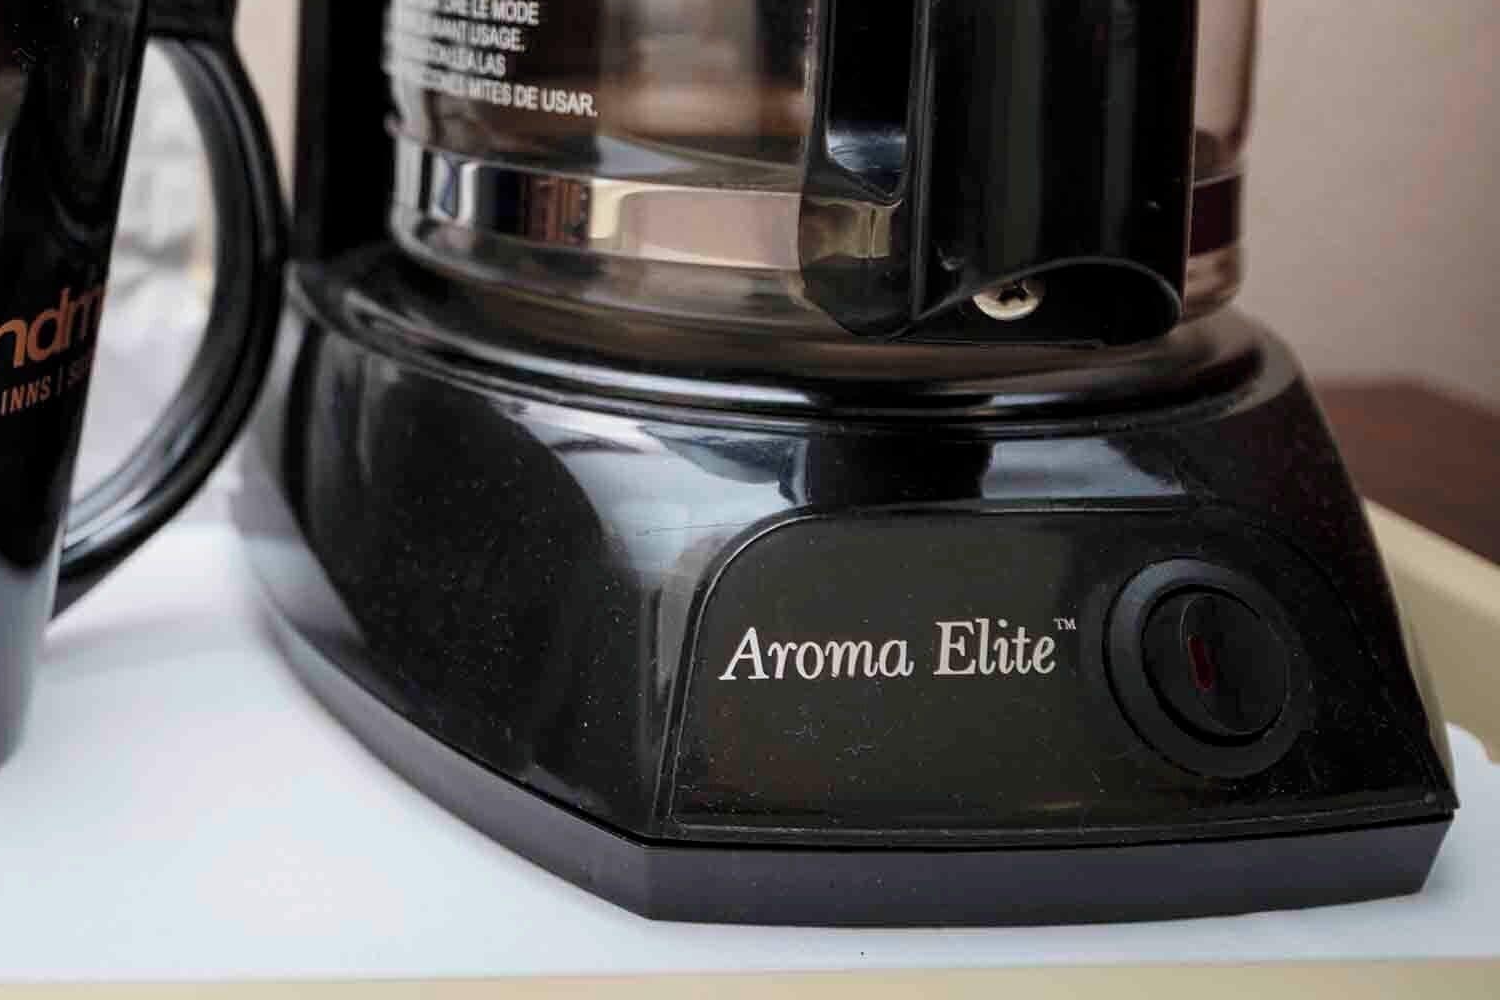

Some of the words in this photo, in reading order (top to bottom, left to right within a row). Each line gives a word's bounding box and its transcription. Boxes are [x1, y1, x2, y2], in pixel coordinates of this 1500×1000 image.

[491, 0, 540, 26] MODE
[470, 24, 526, 52] USAGE.
[513, 83, 539, 109] DE
[541, 88, 598, 118] USAR.
[0, 374, 52, 417] INNS
[718, 625, 914, 681] Aroma
